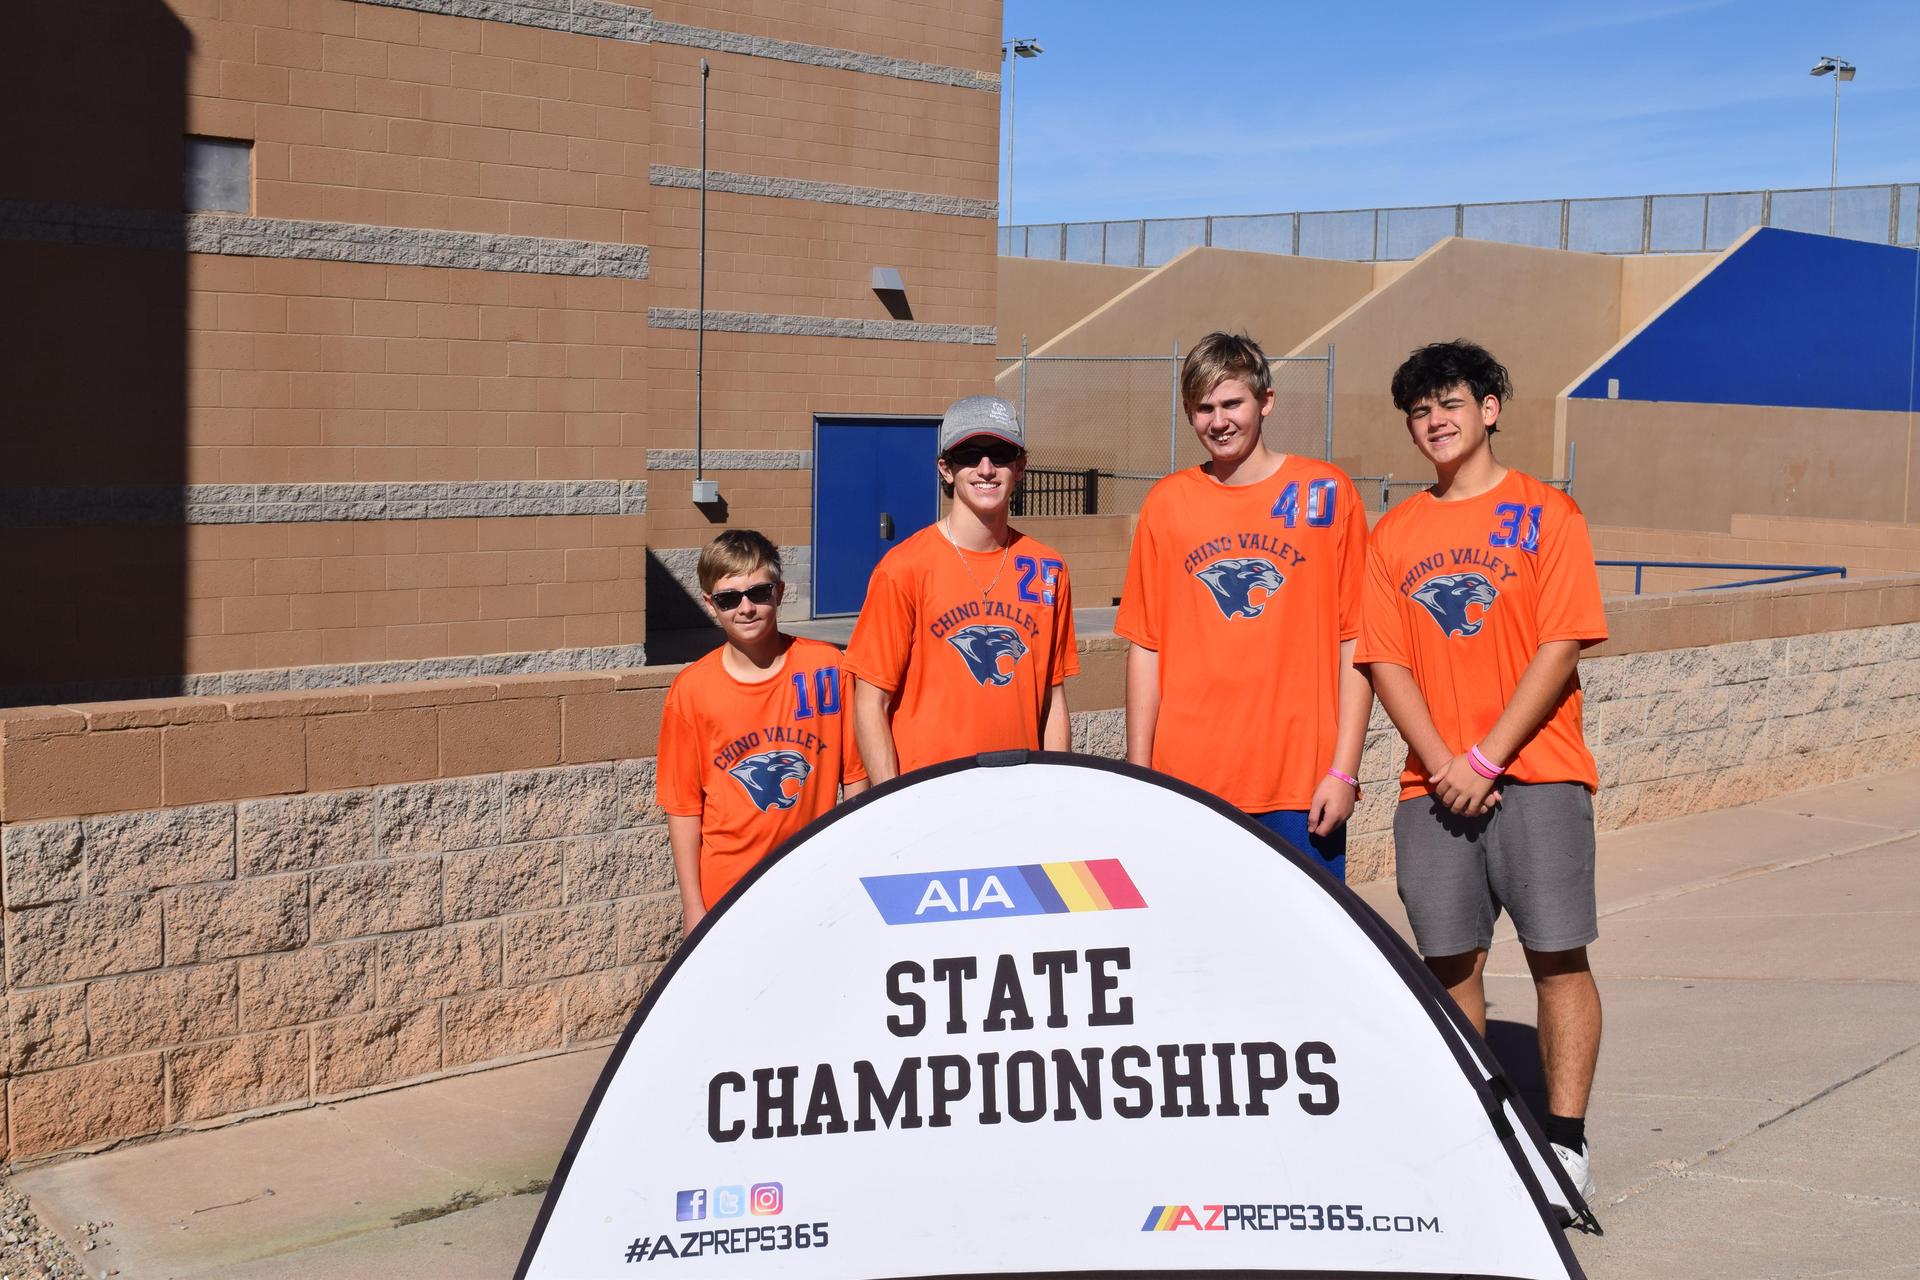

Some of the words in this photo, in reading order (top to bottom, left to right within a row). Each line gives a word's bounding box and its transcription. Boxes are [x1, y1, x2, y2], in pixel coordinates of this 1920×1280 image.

[1271, 478, 1337, 528] 40
[1184, 536, 1231, 574] CHINO
[1238, 533, 1306, 567] VALLEY
[1489, 502, 1543, 556] 31
[1014, 555, 1063, 606] 25
[1400, 552, 1445, 597] CHINO
[1450, 548, 1518, 581] VALLEY
[930, 601, 980, 639] CHINO
[792, 666, 840, 720] 10
[713, 732, 760, 770] CHINO
[763, 726, 827, 755] VALLEY
[914, 875, 1015, 915] AIA
[886, 947, 1134, 1037] STATE
[707, 1041, 1340, 1143] CHAMPIONSHIPS
[624, 1221, 829, 1263] #AZPREPS365
[1169, 1204, 1439, 1233] AZPREPS365.COM
